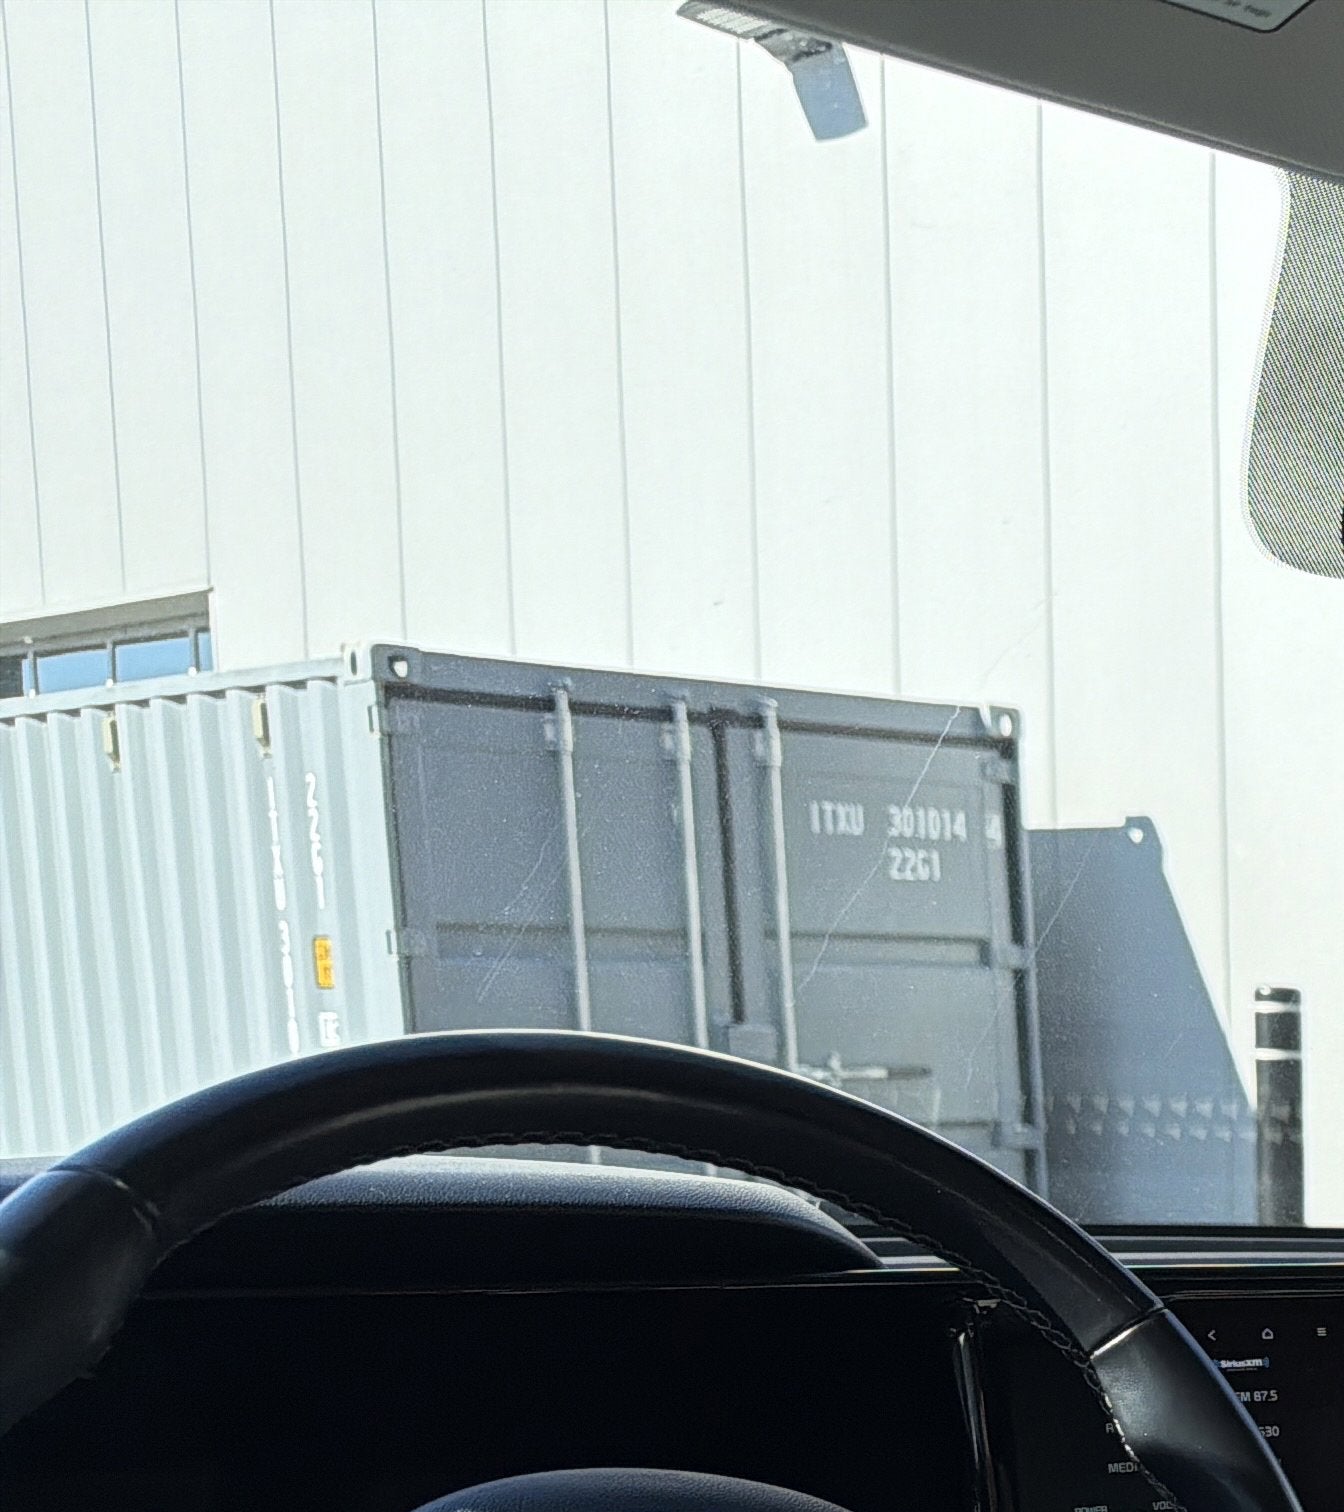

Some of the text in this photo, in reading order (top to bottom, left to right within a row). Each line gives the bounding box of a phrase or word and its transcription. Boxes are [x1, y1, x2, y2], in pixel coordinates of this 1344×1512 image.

[887, 803, 968, 843] 301014
[1253, 1389, 1279, 1402] 87.5
[1108, 1462, 1138, 1474] MEDI
